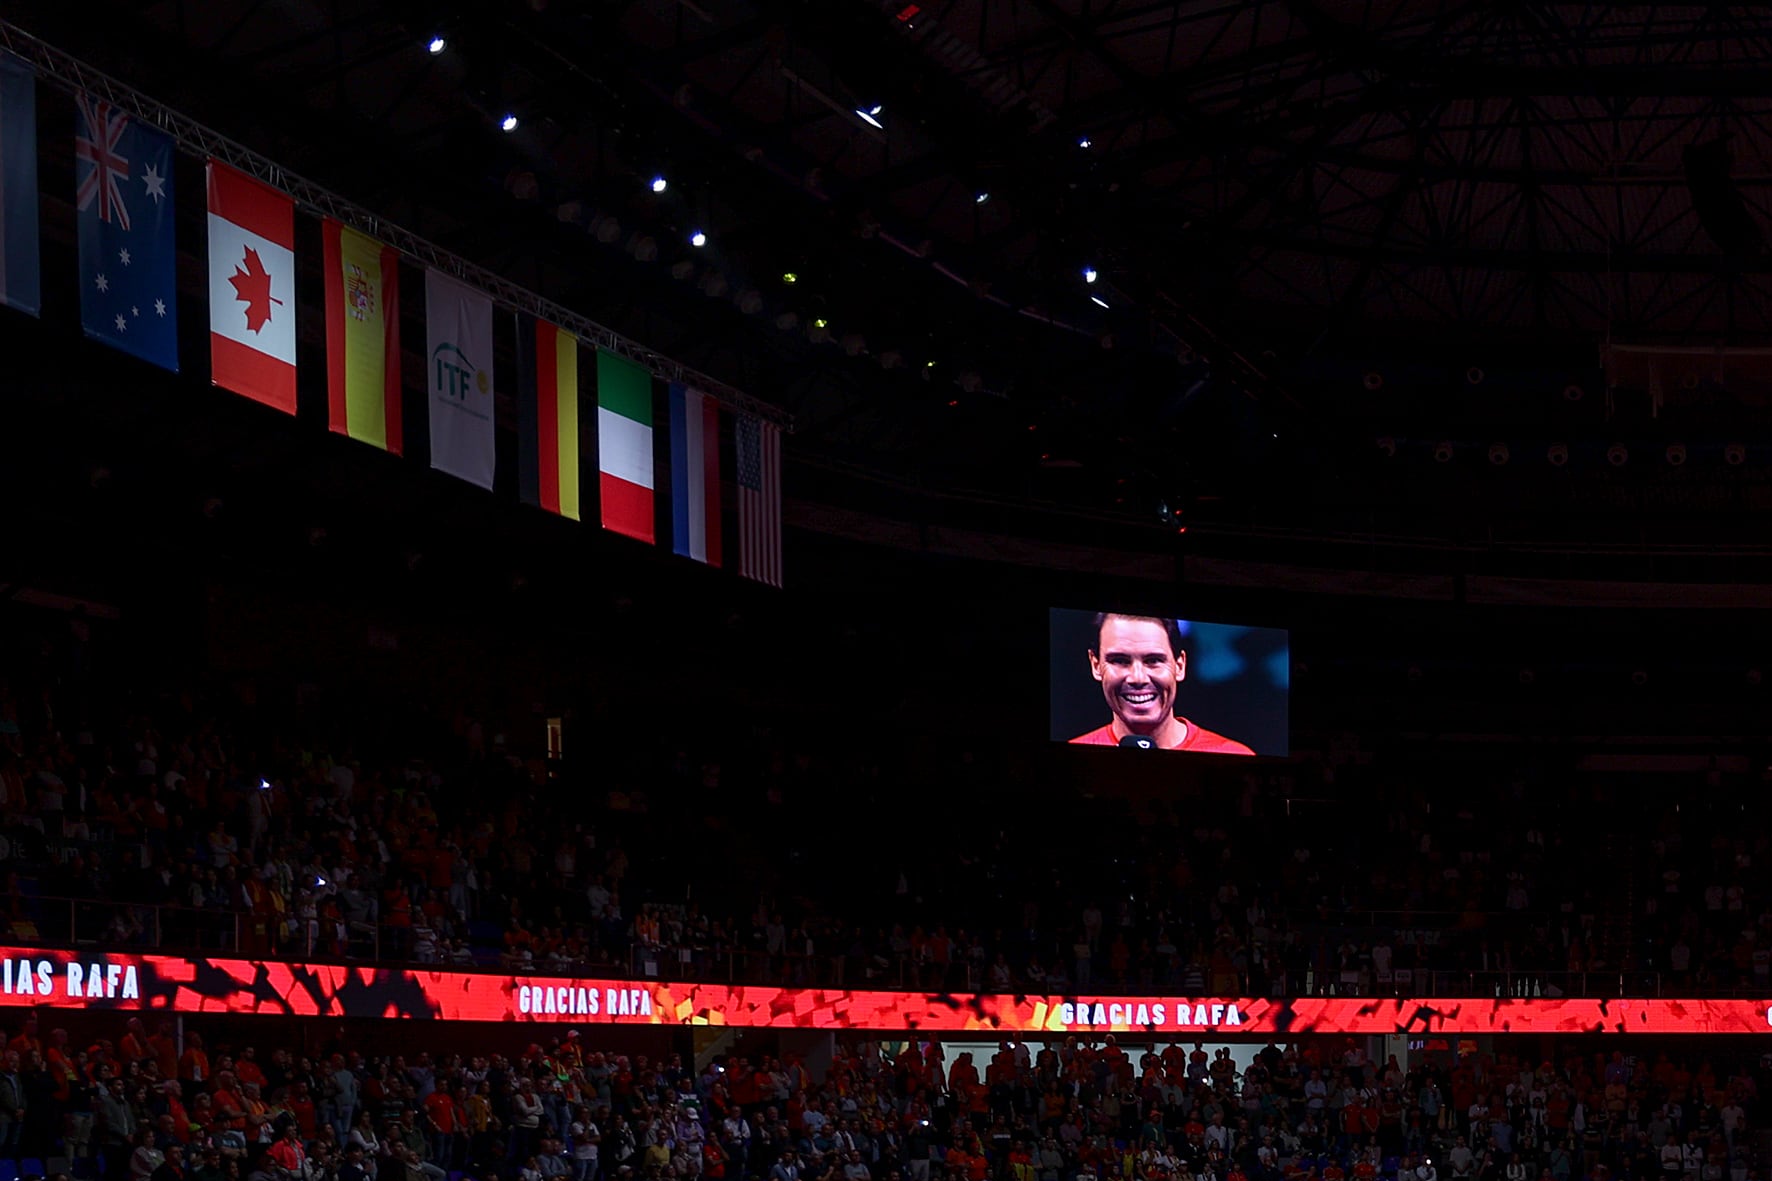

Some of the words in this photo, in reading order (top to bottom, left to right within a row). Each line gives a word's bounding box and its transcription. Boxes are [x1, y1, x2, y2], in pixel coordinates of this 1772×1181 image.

[437, 358, 470, 400] ITF
[66, 961, 139, 1000] RAFA
[518, 985, 599, 1015] GRACIAS
[606, 987, 652, 1017] RAFA
[1060, 1003, 1165, 1025] GRACIAS
[1177, 1003, 1241, 1026] RAFA
